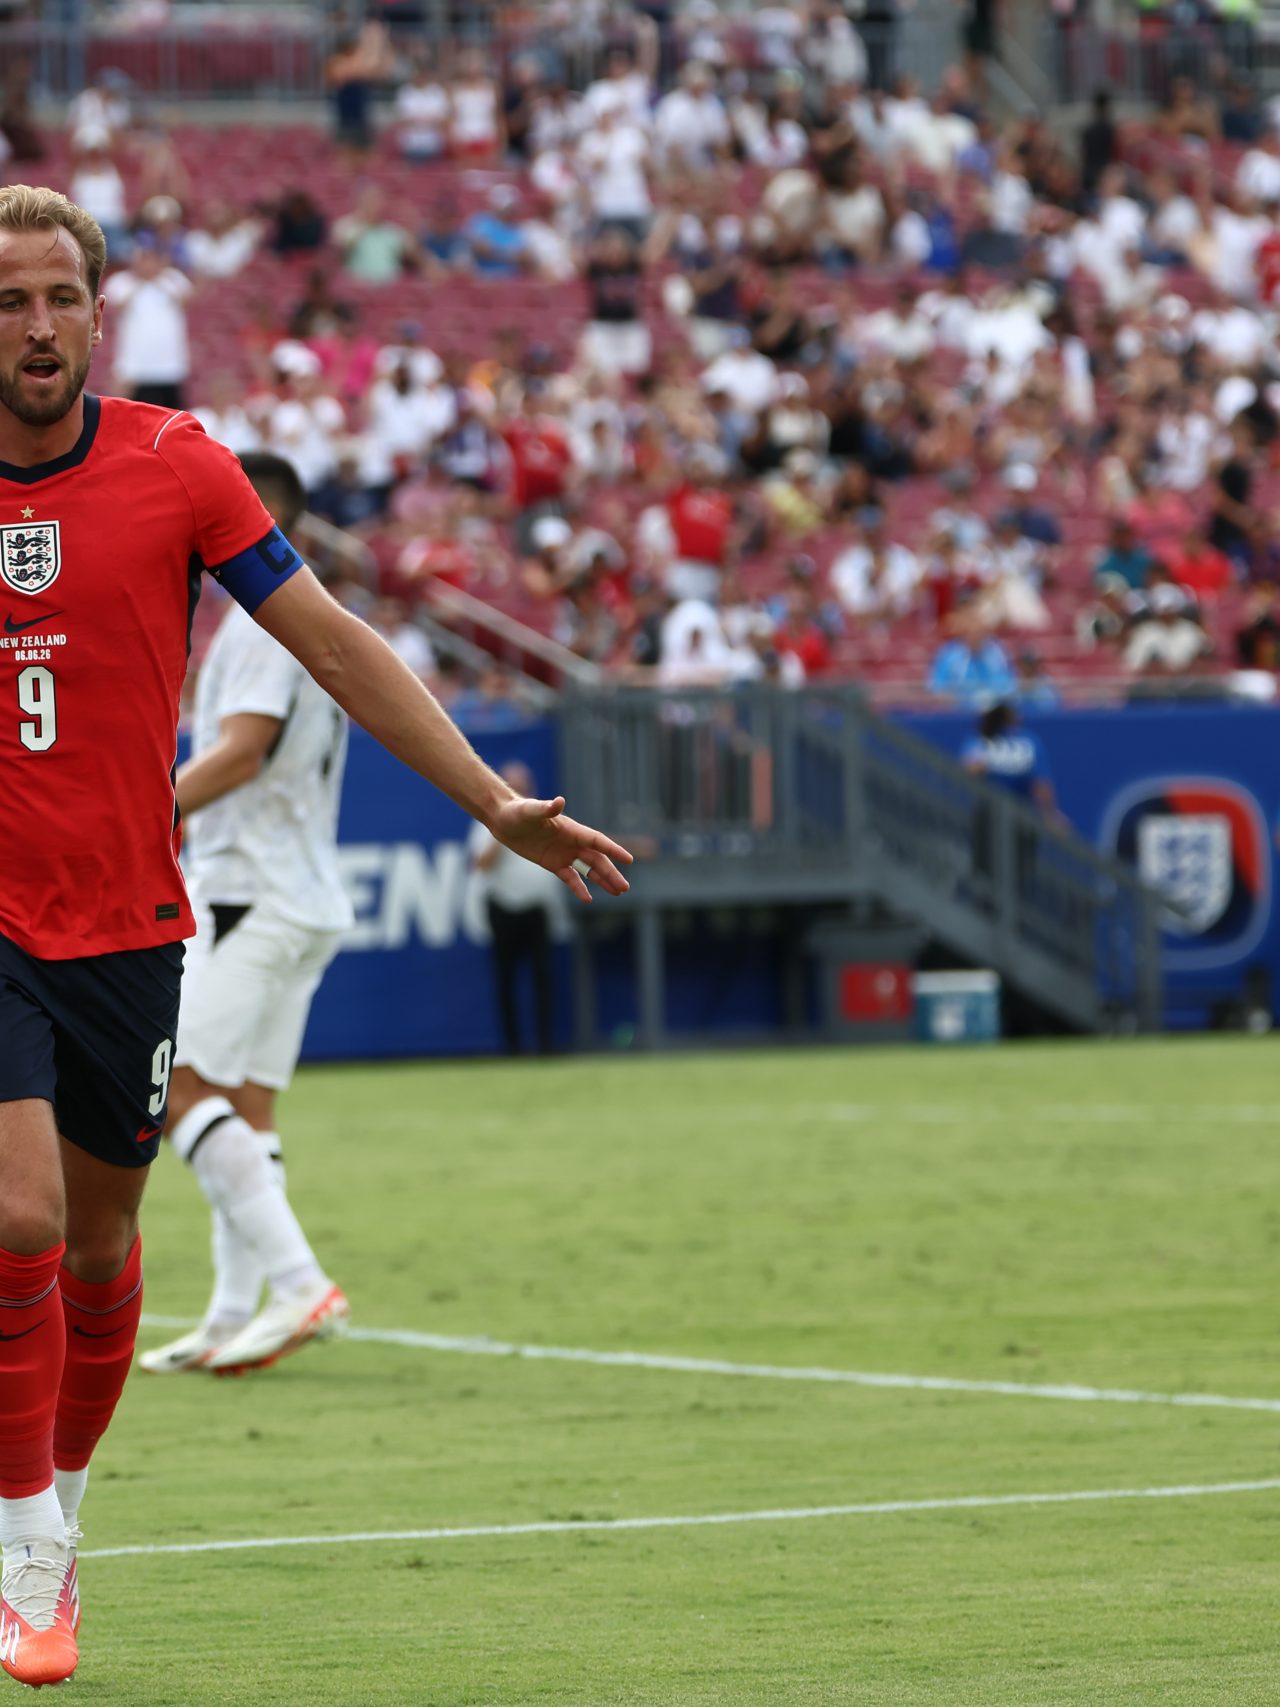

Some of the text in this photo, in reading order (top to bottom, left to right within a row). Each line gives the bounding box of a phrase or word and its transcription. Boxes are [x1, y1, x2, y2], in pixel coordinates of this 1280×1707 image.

[256, 528, 296, 575] C
[15, 648, 51, 661] 06.06.26
[21, 634, 67, 647] ZEALAND
[18, 666, 57, 751] 9
[149, 1038, 172, 1117] 9
